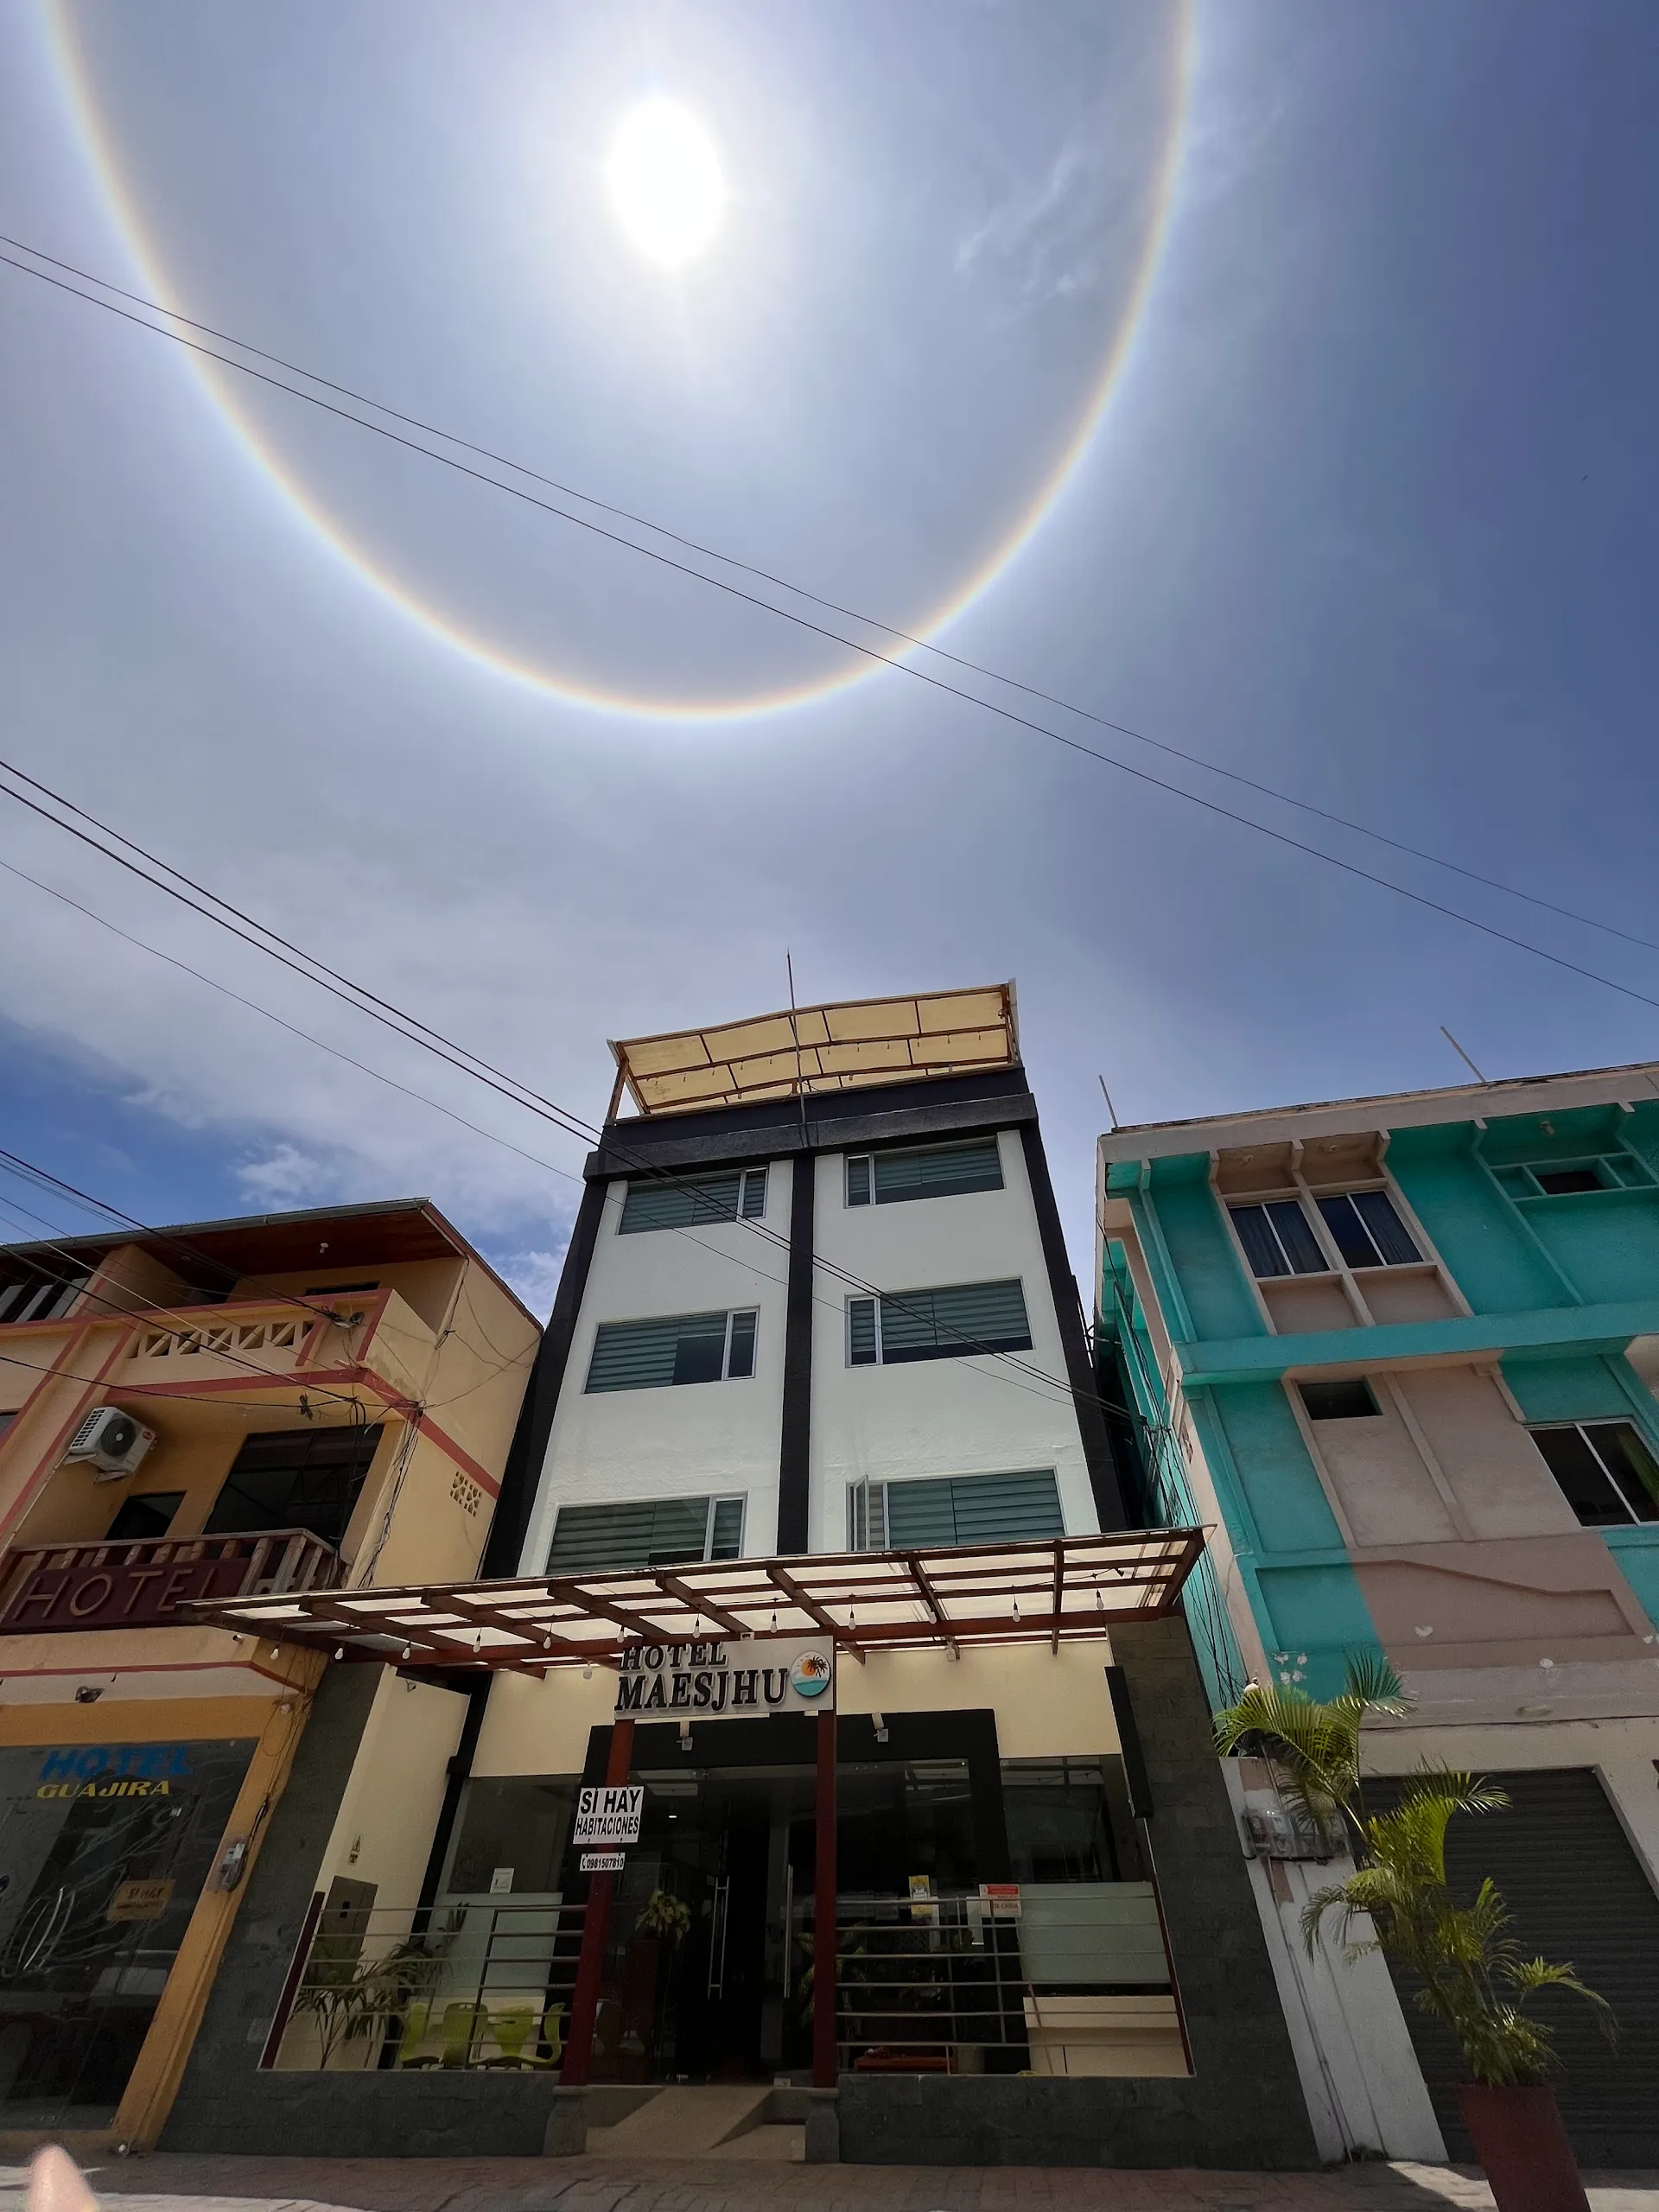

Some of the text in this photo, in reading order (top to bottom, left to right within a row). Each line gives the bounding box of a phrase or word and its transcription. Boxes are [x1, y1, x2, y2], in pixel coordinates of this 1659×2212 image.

[620, 1642, 728, 1671] HOTEL
[614, 1668, 788, 1711] MAESJHU
[39, 1745, 192, 1782] HOTEL
[36, 1780, 171, 1799] GUAJIRA
[581, 1789, 641, 1815] SI HAY
[575, 1816, 639, 1836] HABITACIONES
